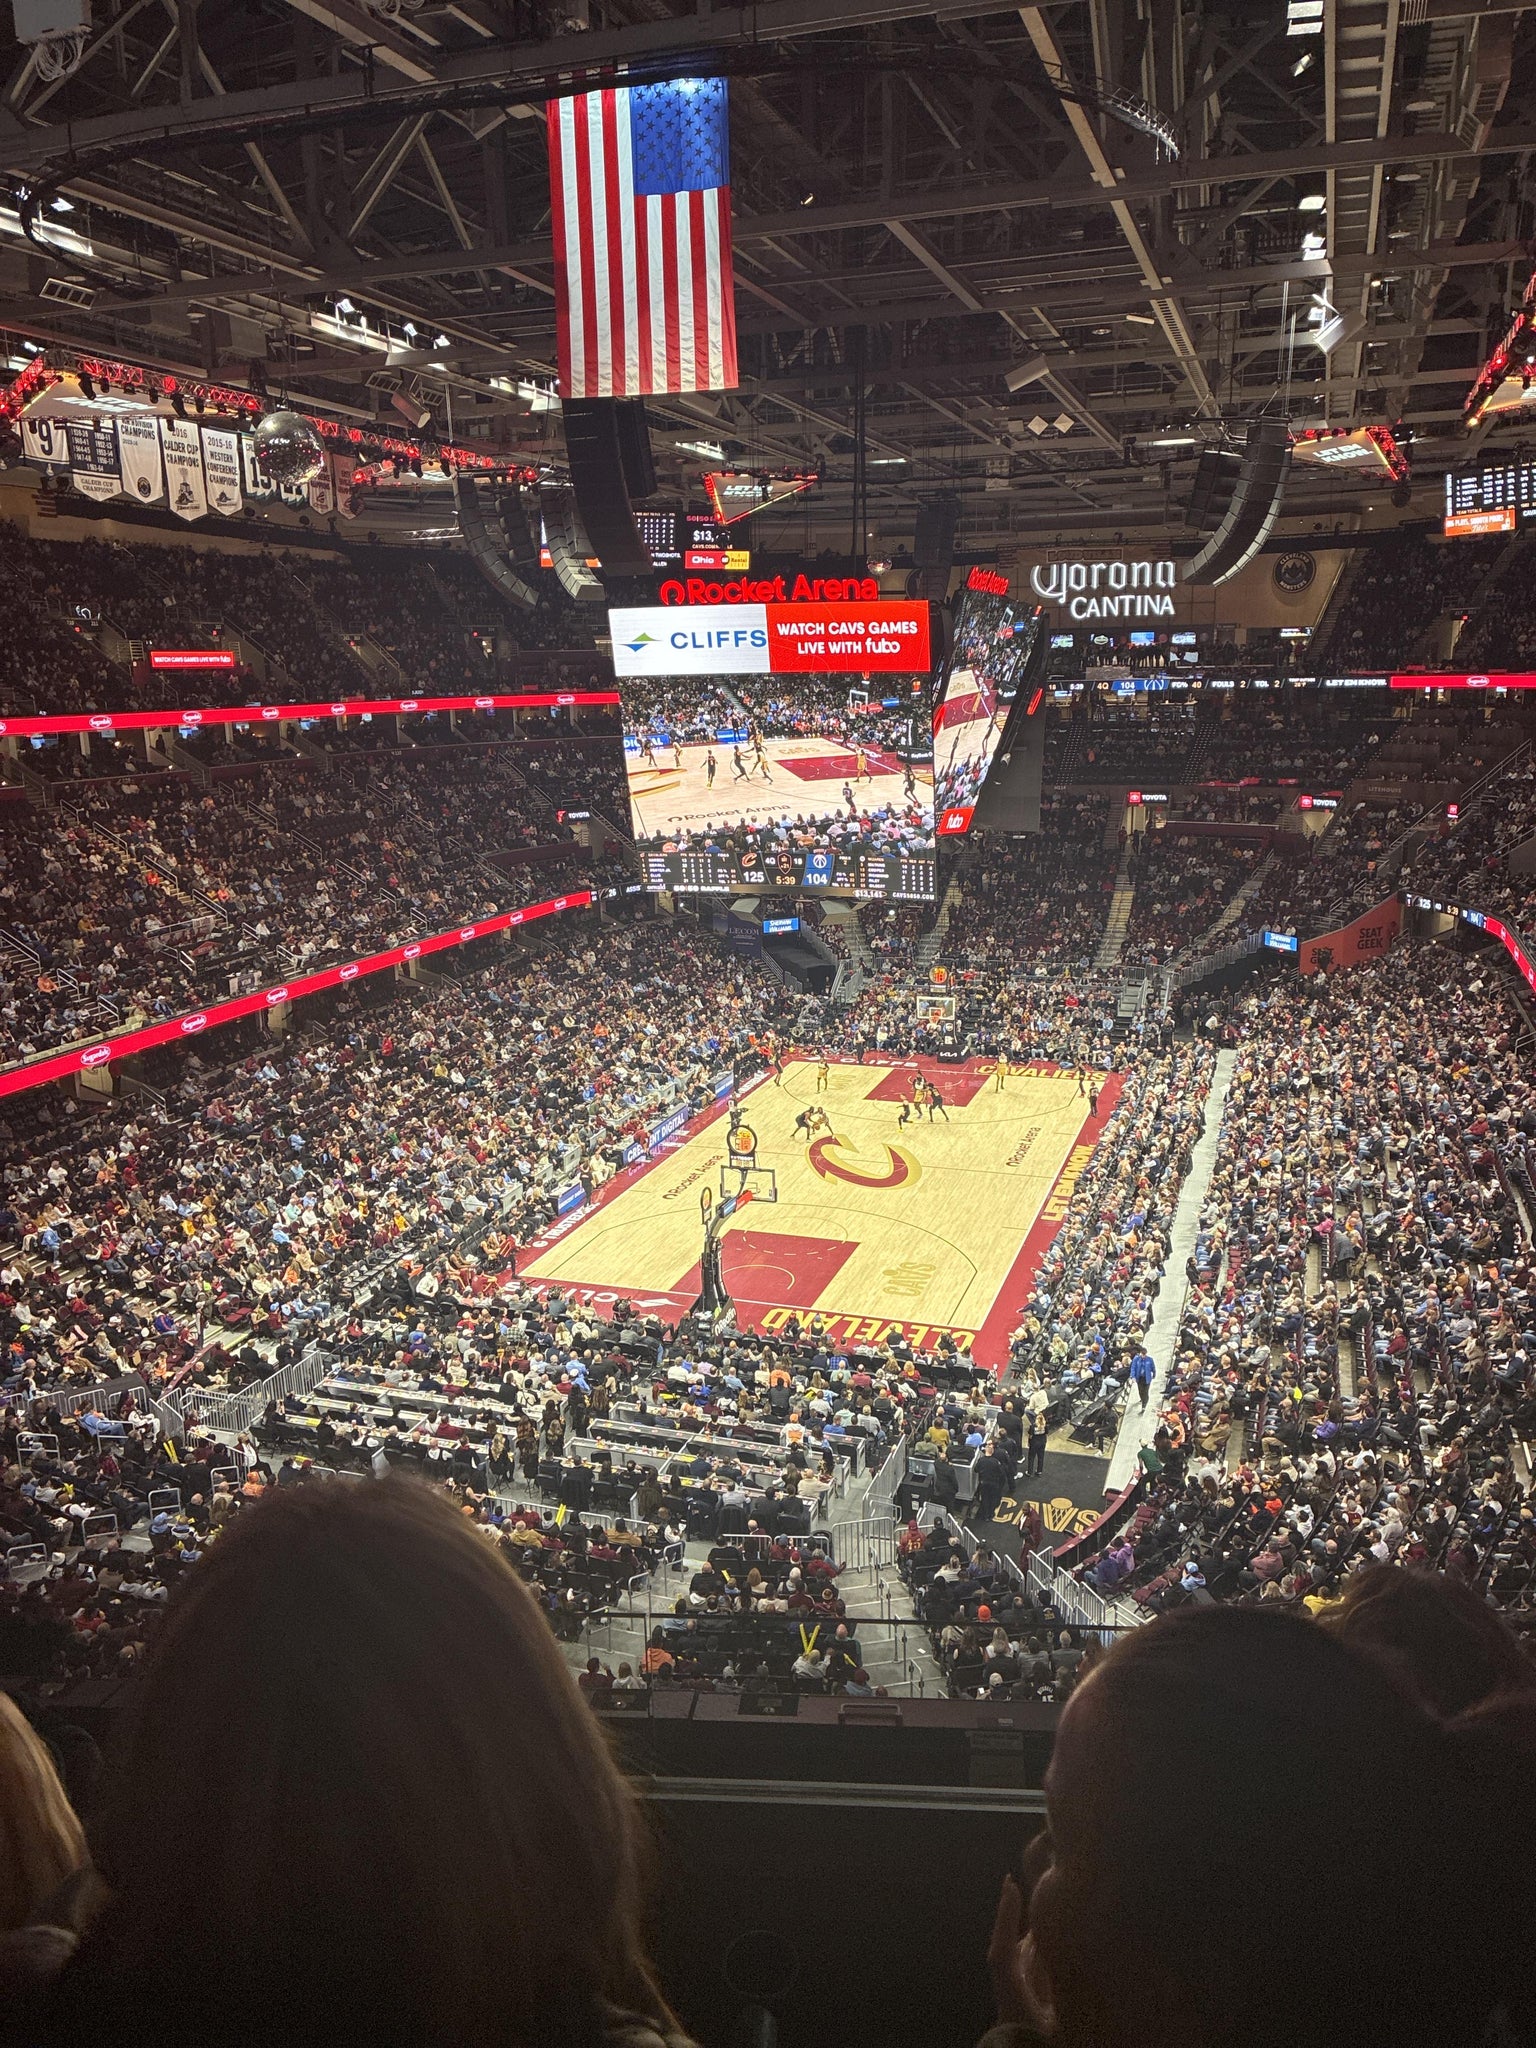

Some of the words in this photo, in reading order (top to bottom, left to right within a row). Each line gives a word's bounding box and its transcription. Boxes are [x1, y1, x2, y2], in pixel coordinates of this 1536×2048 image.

[38, 419, 53, 456] 9
[120, 425, 156, 440] CHAMPIONS
[172, 427, 188, 438] 2016
[163, 440, 188, 452] CALDER
[187, 445, 199, 455] CUP
[207, 436, 233, 450] 2015-16
[166, 454, 200, 468] CHAMPIONS
[209, 450, 234, 464] WESTERN
[207, 461, 239, 476] CONFERENCE
[209, 474, 239, 488] CHAMPIONS
[692, 555, 714, 564] Ohio
[1279, 552, 1310, 565] CLEVELAND
[1030, 561, 1176, 603] Corona
[1279, 579, 1308, 591] MONSTERS
[687, 576, 786, 604] Rocket
[792, 574, 879, 601] Arena
[1070, 594, 1176, 620] CANTINA
[776, 622, 825, 635] WATCH
[828, 621, 866, 635] CAVS
[868, 620, 918, 634] GAMES
[670, 629, 767, 649] CLIFFS
[797, 641, 827, 655] LIVE
[828, 640, 863, 654] WITH
[865, 640, 901, 654] fubo
[1097, 682, 1109, 691] 4Q
[1120, 681, 1136, 689] 104
[1192, 681, 1202, 689] 40
[1212, 680, 1235, 688] FOULS
[1274, 680, 1281, 688] 2
[1326, 679, 1344, 687] LET
[1358, 679, 1387, 687] KNOW.
[1312, 799, 1337, 807] TOYOTA
[568, 811, 590, 819] TOYOTA
[684, 808, 742, 821] Rocket
[745, 804, 790, 814] Arena
[946, 814, 964, 830] fubo
[743, 871, 765, 883] 125
[776, 876, 796, 885] 5:39
[806, 873, 828, 884] 104
[1419, 898, 1431, 910] 125
[1447, 905, 1459, 916] 5:39
[729, 928, 759, 936] LECOM
[1270, 933, 1291, 943] SHERWIN
[1359, 926, 1384, 939] SEAT
[1357, 938, 1383, 950] GEEK
[661, 1113, 685, 1141] DIGITAL
[1040, 1196, 1070, 1222] LET
